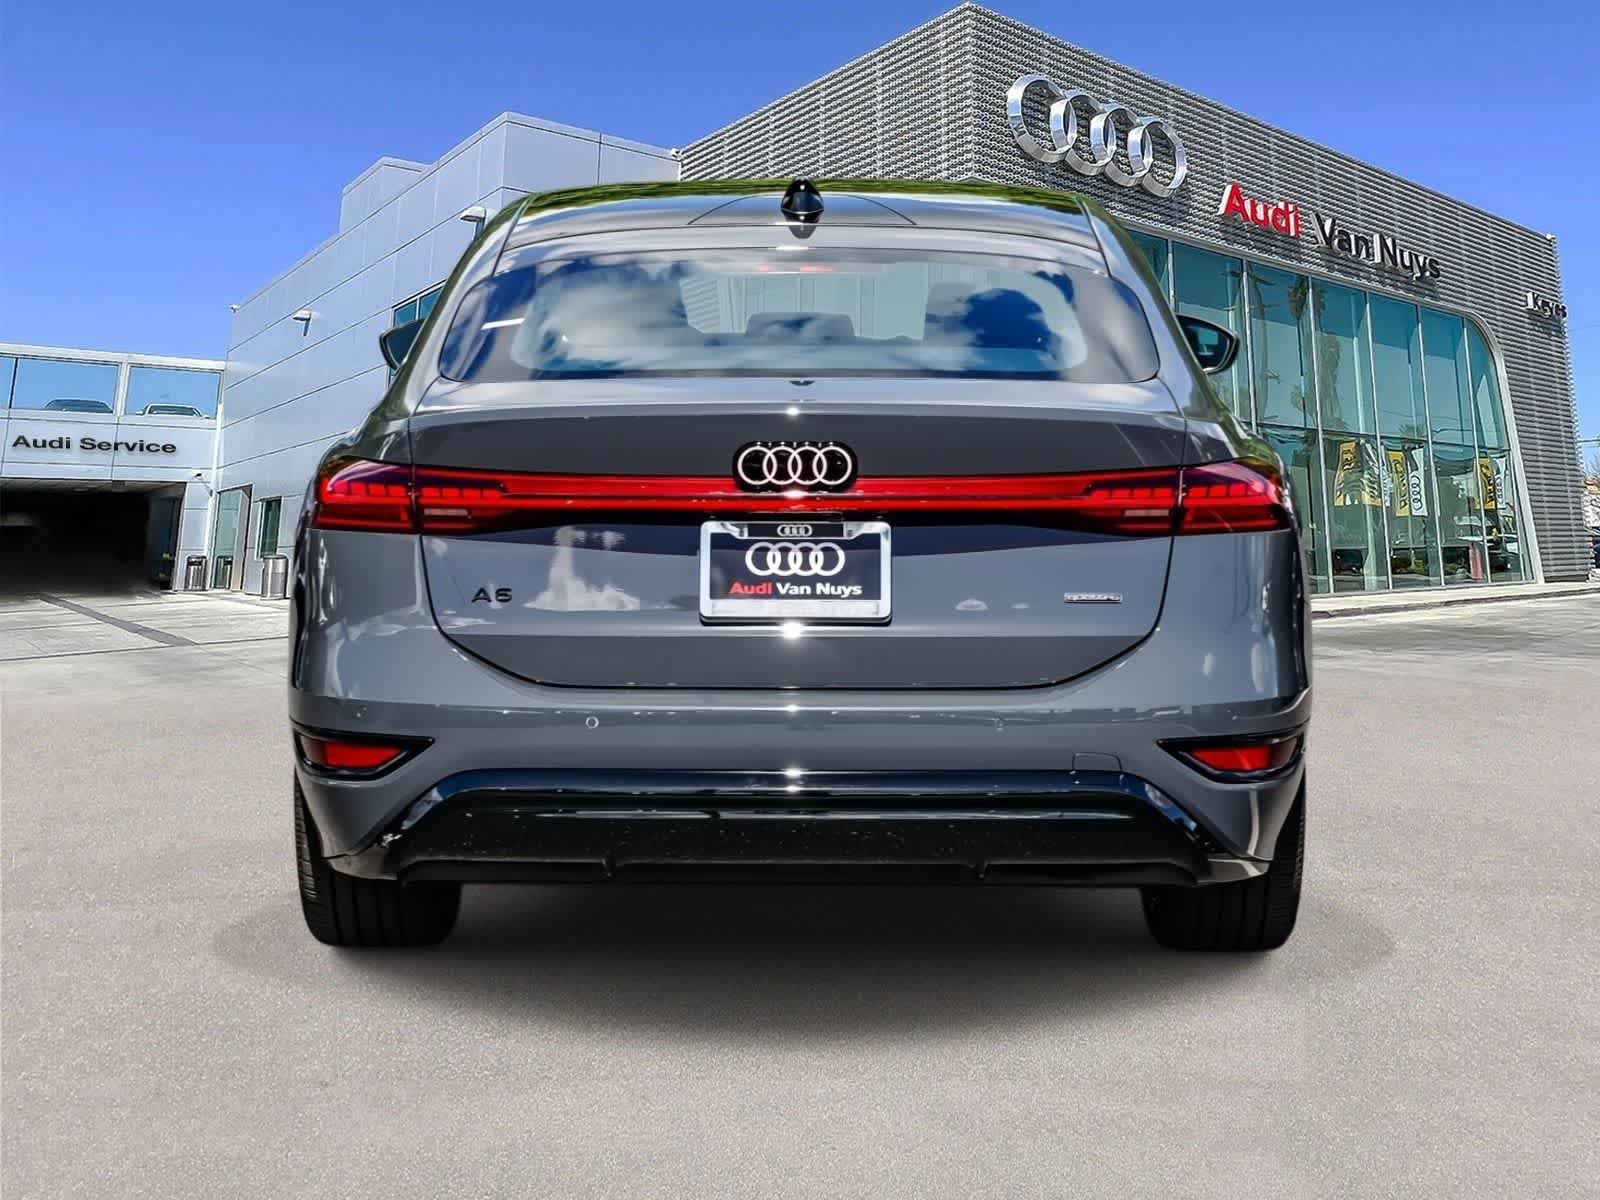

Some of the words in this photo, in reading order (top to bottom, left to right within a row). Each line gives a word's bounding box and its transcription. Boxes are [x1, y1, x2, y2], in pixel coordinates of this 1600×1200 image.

[1217, 183, 1301, 238] Audi
[1312, 212, 1373, 262] Van
[1373, 233, 1441, 280] Nuys
[12, 435, 72, 450] Audi
[79, 437, 177, 454] Service
[471, 587, 513, 603] A6
[729, 581, 773, 595] Audi
[776, 582, 811, 595] Van
[815, 582, 863, 598] Nuys
